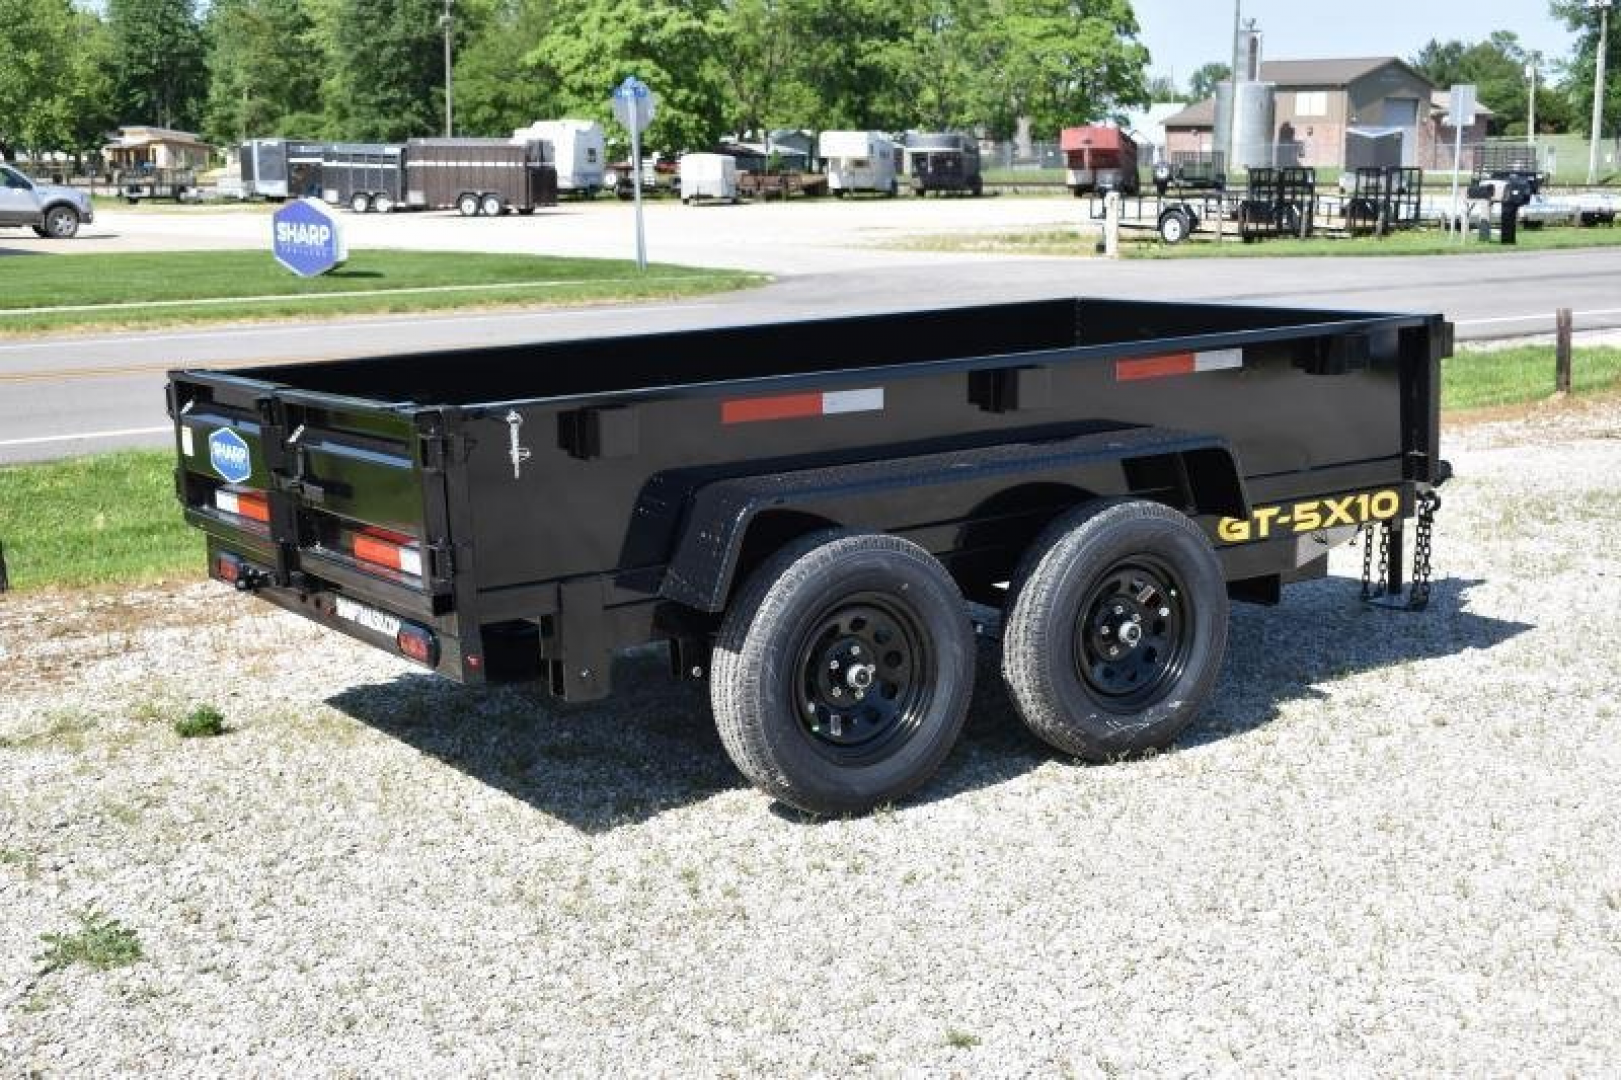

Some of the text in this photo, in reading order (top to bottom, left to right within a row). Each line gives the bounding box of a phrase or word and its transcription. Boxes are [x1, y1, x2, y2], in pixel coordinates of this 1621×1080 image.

[277, 222, 331, 245] SHARP
[212, 441, 246, 463] SHARP
[1217, 489, 1399, 542] GT-5X10
